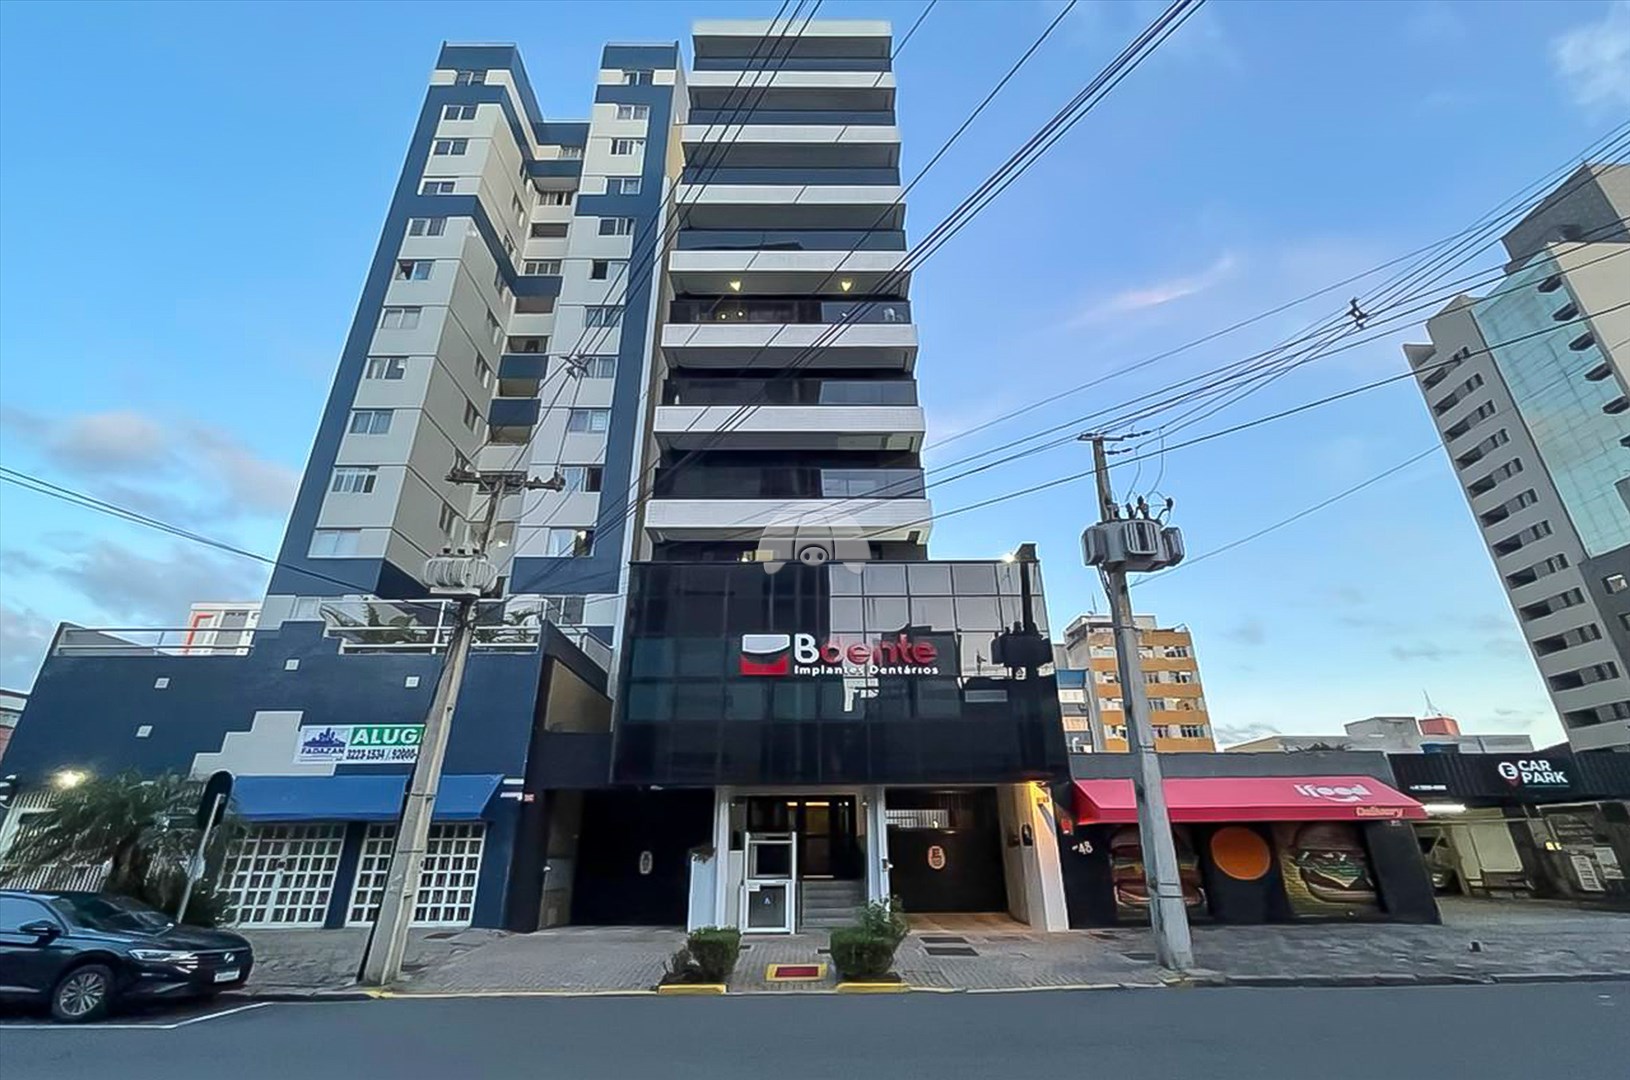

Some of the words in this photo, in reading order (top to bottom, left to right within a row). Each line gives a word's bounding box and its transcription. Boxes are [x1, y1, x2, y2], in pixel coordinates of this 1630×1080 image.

[794, 633, 938, 664] Bdente
[794, 665, 863, 677] Implantes
[869, 664, 940, 675] Dentários
[351, 728, 421, 744] ALUG
[1517, 759, 1552, 772] CAR
[1521, 771, 1569, 784] PARK
